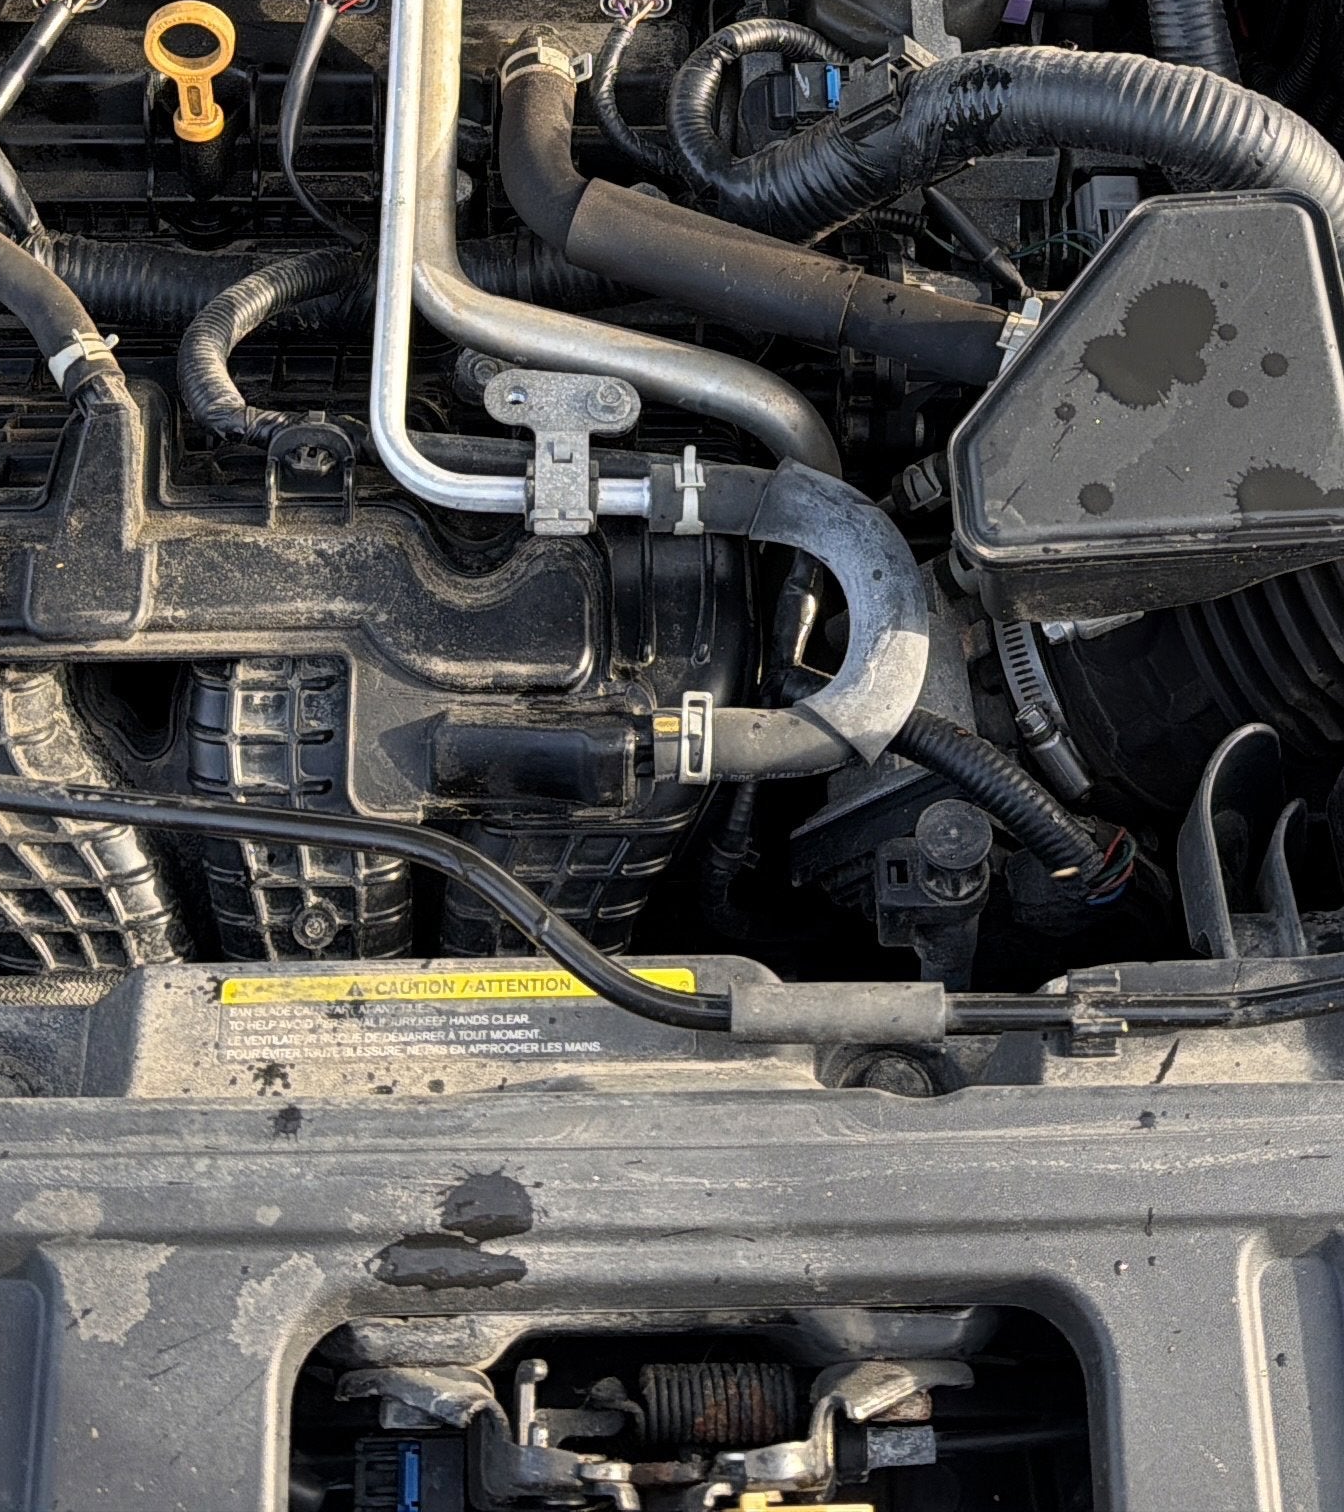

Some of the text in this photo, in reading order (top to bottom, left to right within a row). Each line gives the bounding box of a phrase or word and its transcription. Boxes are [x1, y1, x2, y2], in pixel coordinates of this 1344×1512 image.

[375, 977, 455, 996] CAUTION
[472, 977, 572, 994] ATTENTION
[229, 1020, 245, 1031] TO
[448, 1014, 489, 1026] HANDS
[491, 1013, 531, 1025] CLEAR.
[364, 1032, 382, 1043] DE
[384, 1029, 445, 1043] DÉMARRER
[447, 1027, 457, 1041] À
[458, 1029, 488, 1041] TOUT
[490, 1028, 543, 1040] MOMENT.
[226, 1049, 259, 1060] POUR
[449, 1044, 466, 1055] EN
[467, 1042, 539, 1055] APPROCHER
[540, 1042, 563, 1053] LES
[564, 1041, 602, 1053] MAINS.
